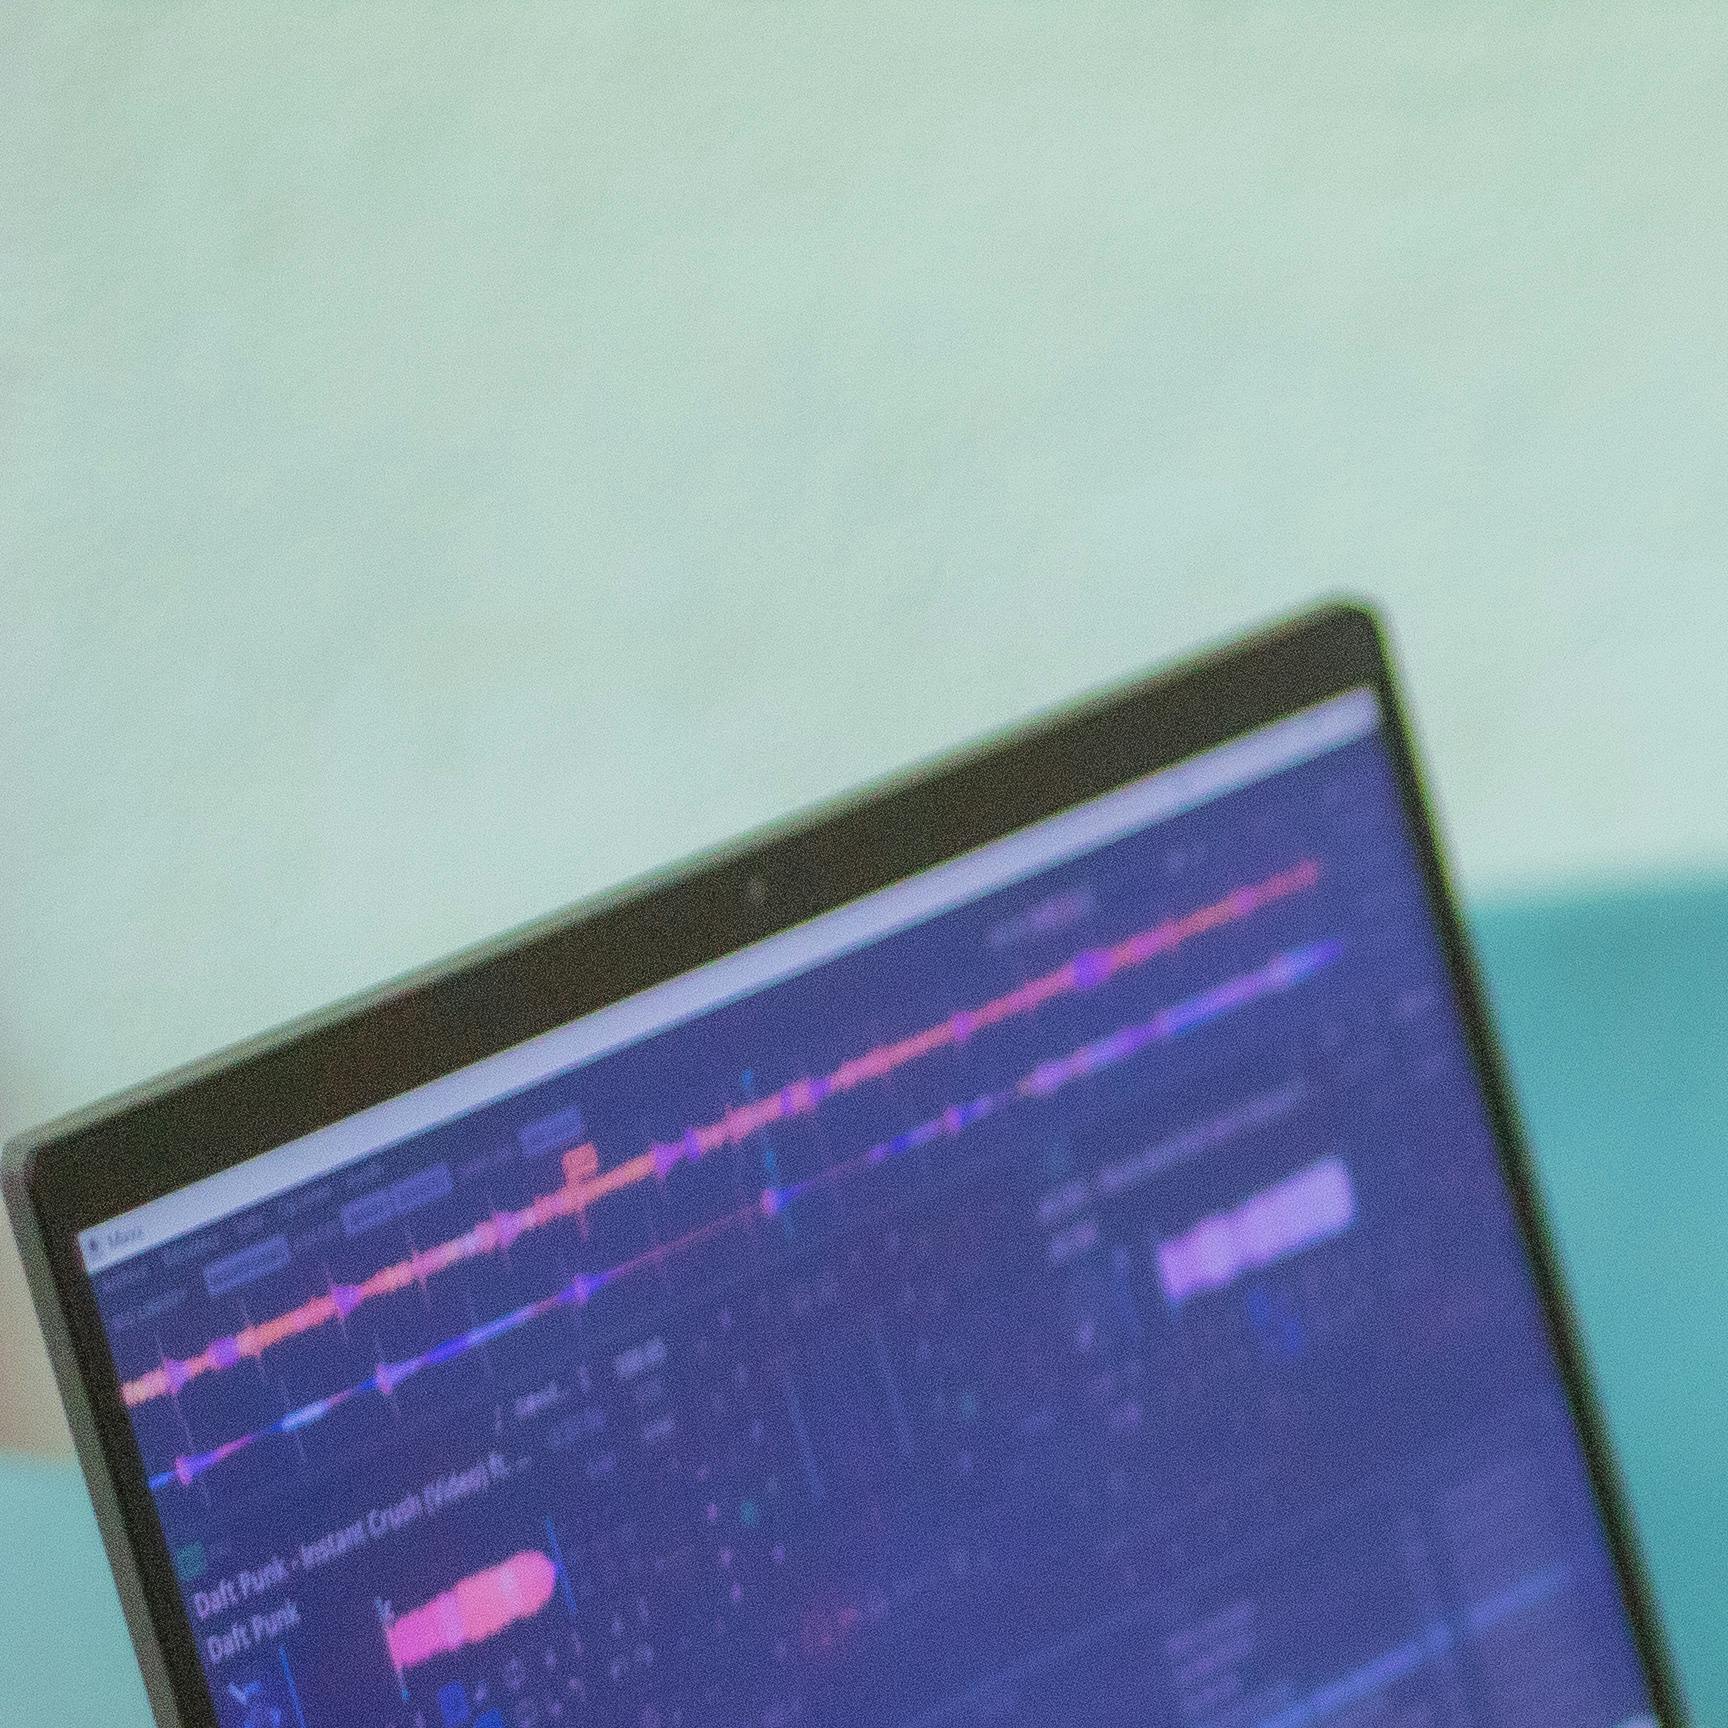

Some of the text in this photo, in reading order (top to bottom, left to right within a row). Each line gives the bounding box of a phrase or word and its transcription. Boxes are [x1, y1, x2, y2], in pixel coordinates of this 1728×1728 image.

[195, 1579, 237, 1620] Daft
[239, 1557, 288, 1597] Punk
[206, 1600, 299, 1664] Daft Punk
